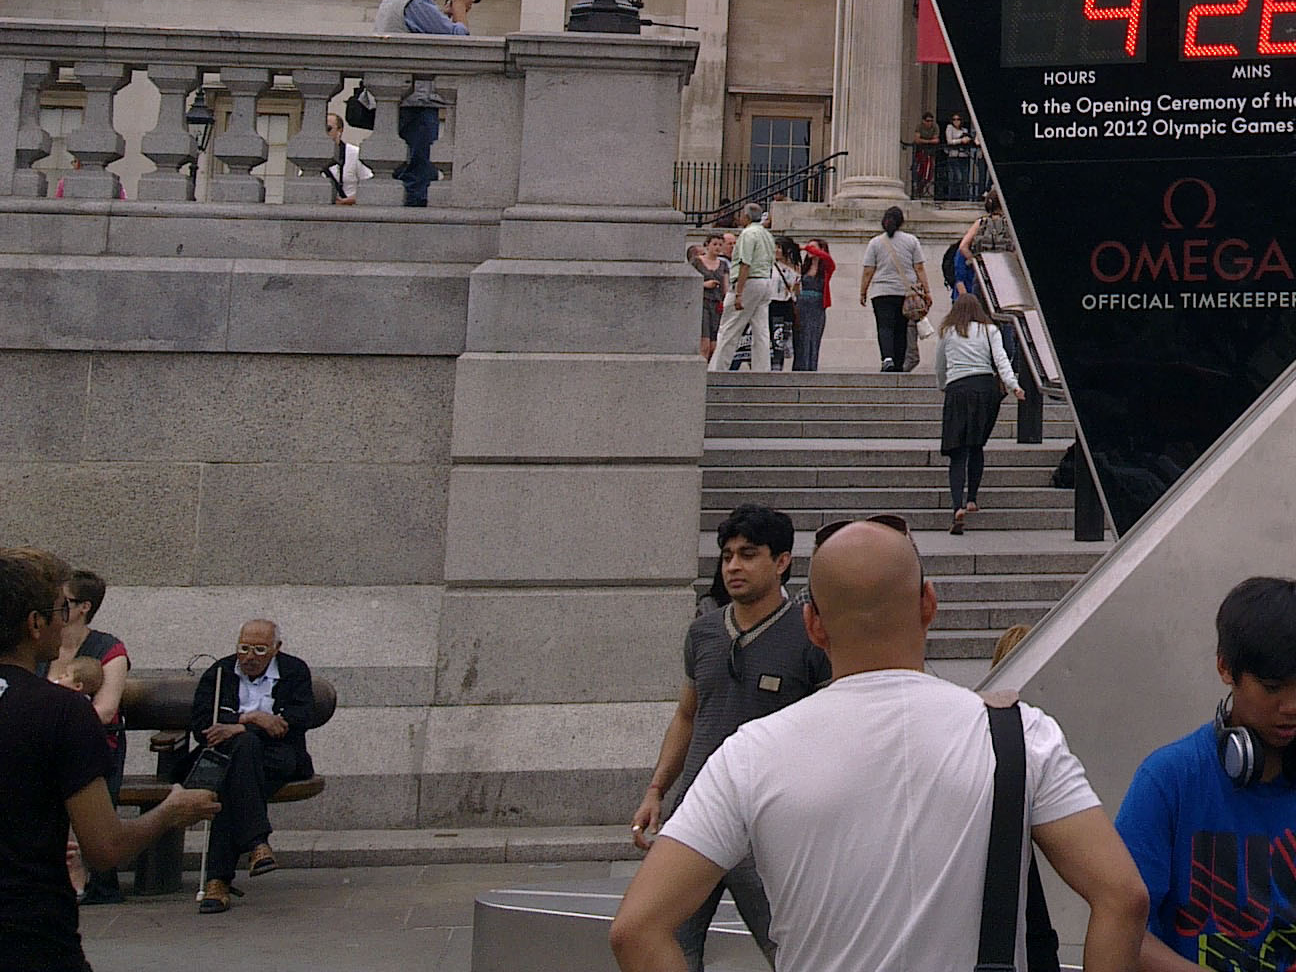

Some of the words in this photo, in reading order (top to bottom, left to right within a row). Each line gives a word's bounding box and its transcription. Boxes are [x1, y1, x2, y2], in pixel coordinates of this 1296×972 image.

[1043, 70, 1097, 86] HOURS
[1231, 64, 1272, 79] MINS
[1020, 100, 1039, 115] to
[1043, 97, 1072, 115] the
[1075, 96, 1152, 118] Opening
[1156, 93, 1248, 114] Ceremony
[1251, 91, 1271, 109] of
[1034, 121, 1098, 139] London
[1103, 119, 1148, 137] 2012
[1152, 118, 1227, 140] Olympic
[1231, 116, 1295, 134] Games
[1089, 237, 1296, 283] OMEGA
[1081, 293, 1175, 310] OFFICIAL
